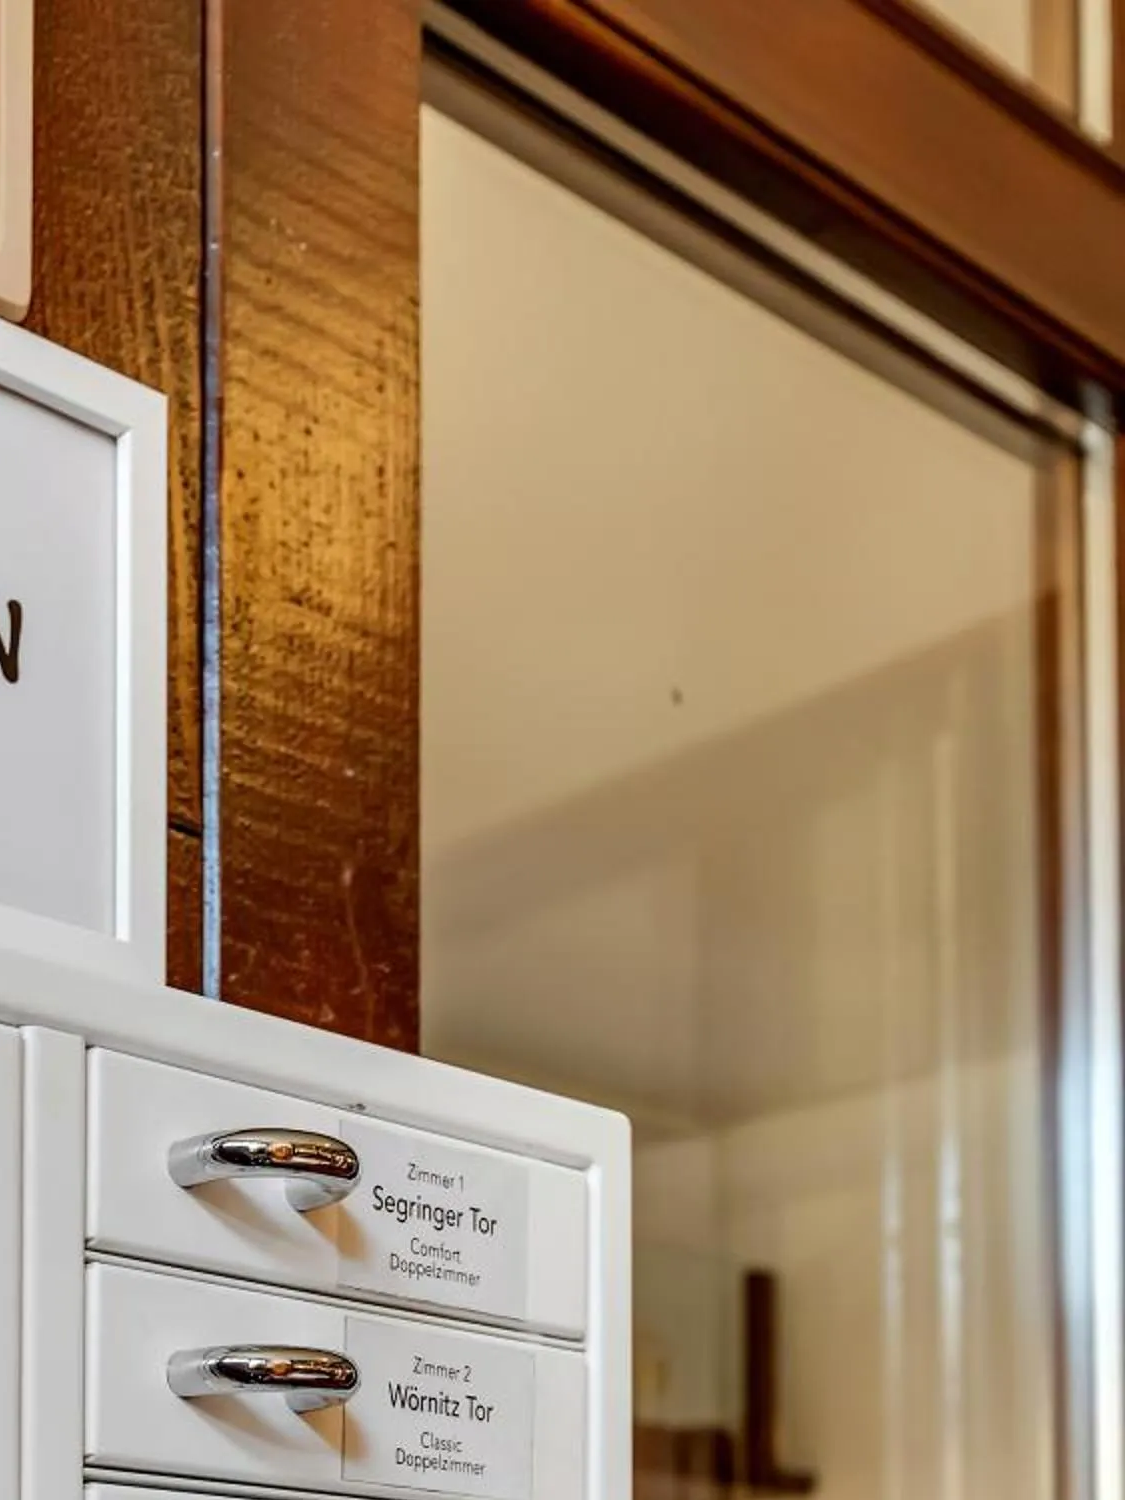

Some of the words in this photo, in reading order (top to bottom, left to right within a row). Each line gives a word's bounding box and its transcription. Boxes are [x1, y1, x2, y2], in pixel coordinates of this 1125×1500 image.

[407, 1163, 456, 1189] Zimmer
[458, 1175, 465, 1191] 1
[372, 1185, 464, 1230] Segringer
[469, 1207, 498, 1236] Tor
[409, 1237, 462, 1264] Comfort
[389, 1253, 481, 1287] Doppelzimmer
[412, 1356, 461, 1383] Zimmer
[463, 1366, 472, 1383] 2
[387, 1381, 461, 1418] Wörnitz
[465, 1395, 495, 1423] Tor
[420, 1431, 463, 1453] Classic
[395, 1447, 486, 1476] Doppelzimmer
